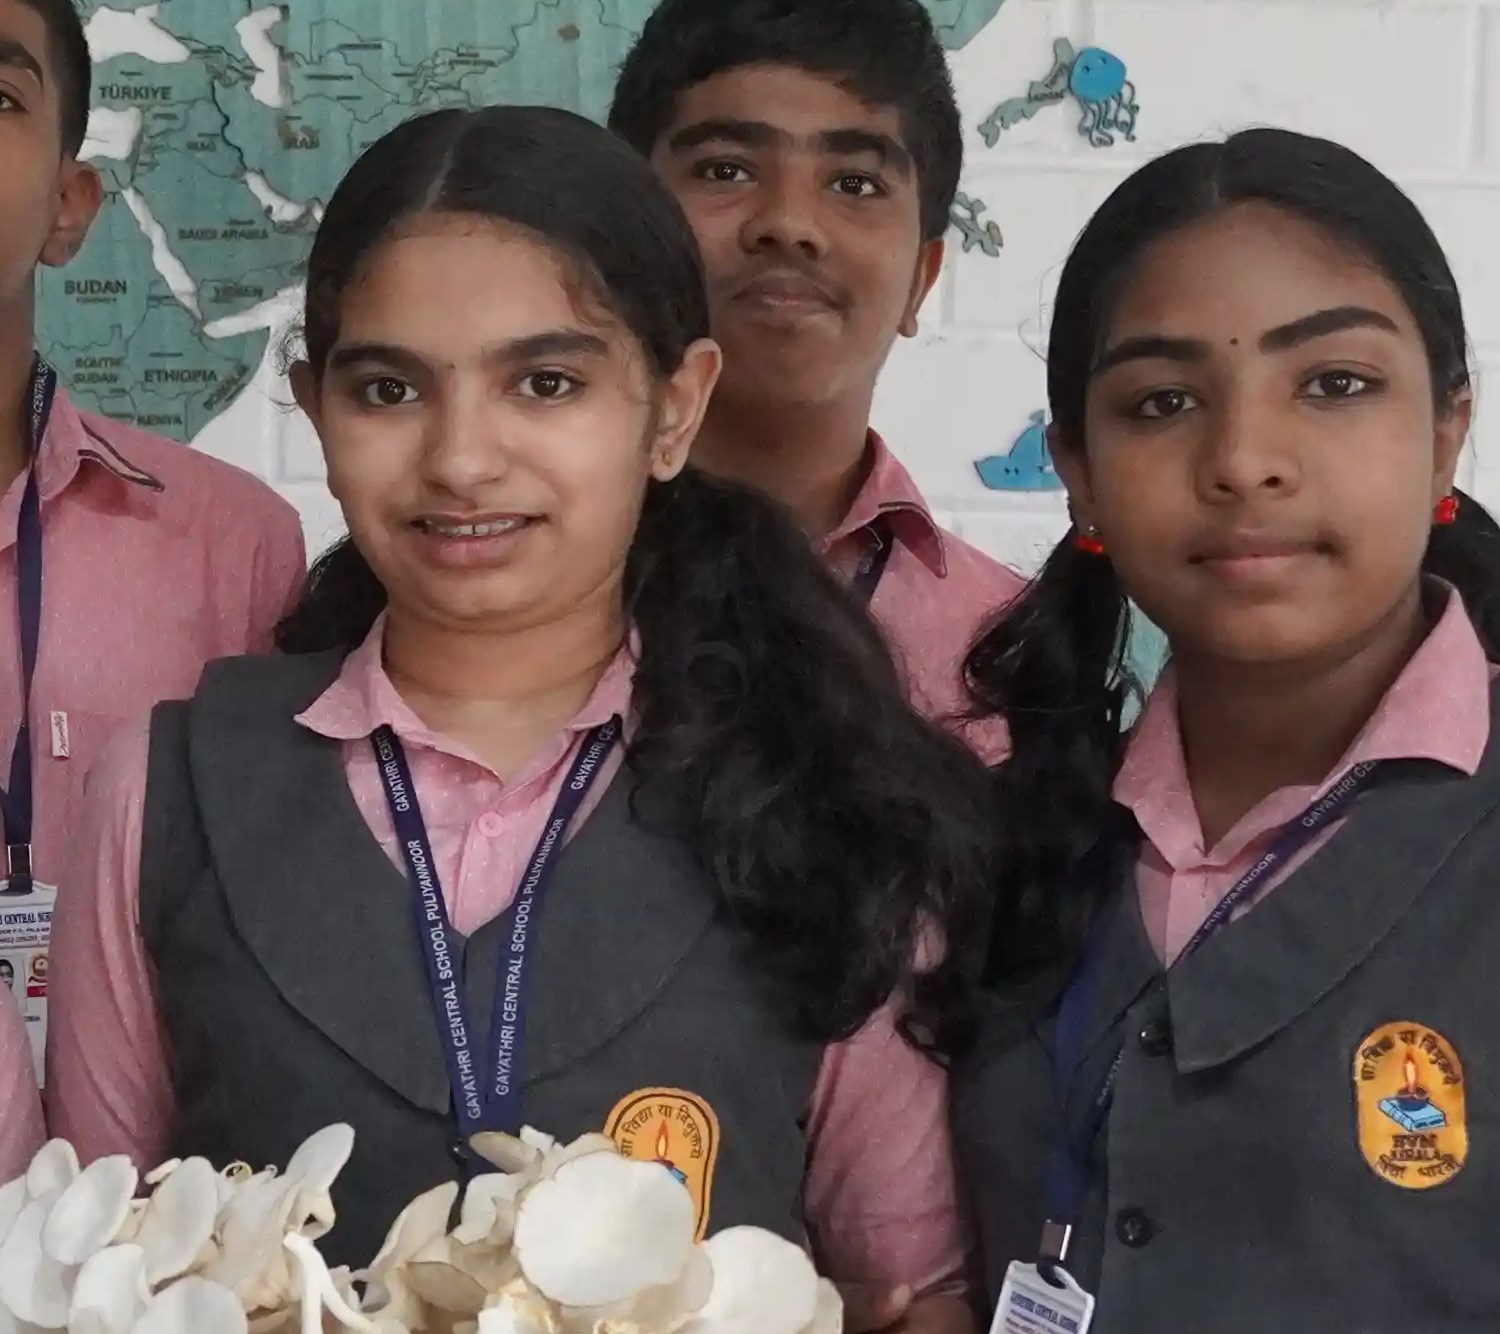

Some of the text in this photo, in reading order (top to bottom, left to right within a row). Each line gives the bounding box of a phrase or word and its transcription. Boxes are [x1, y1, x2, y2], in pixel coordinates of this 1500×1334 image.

[144, 369, 218, 384] ETHIOPIA
[383, 760, 410, 812] GAYATHRI
[570, 741, 605, 790] GAYATHRI
[1303, 776, 1358, 828] GAYATHRI
[407, 839, 482, 1120] GAYATHRI CENTRAL SCHOOL PULIYANNOOR
[495, 817, 565, 1096] GAYATHRI CENTRAL SCHOOL PULIYANNOOR
